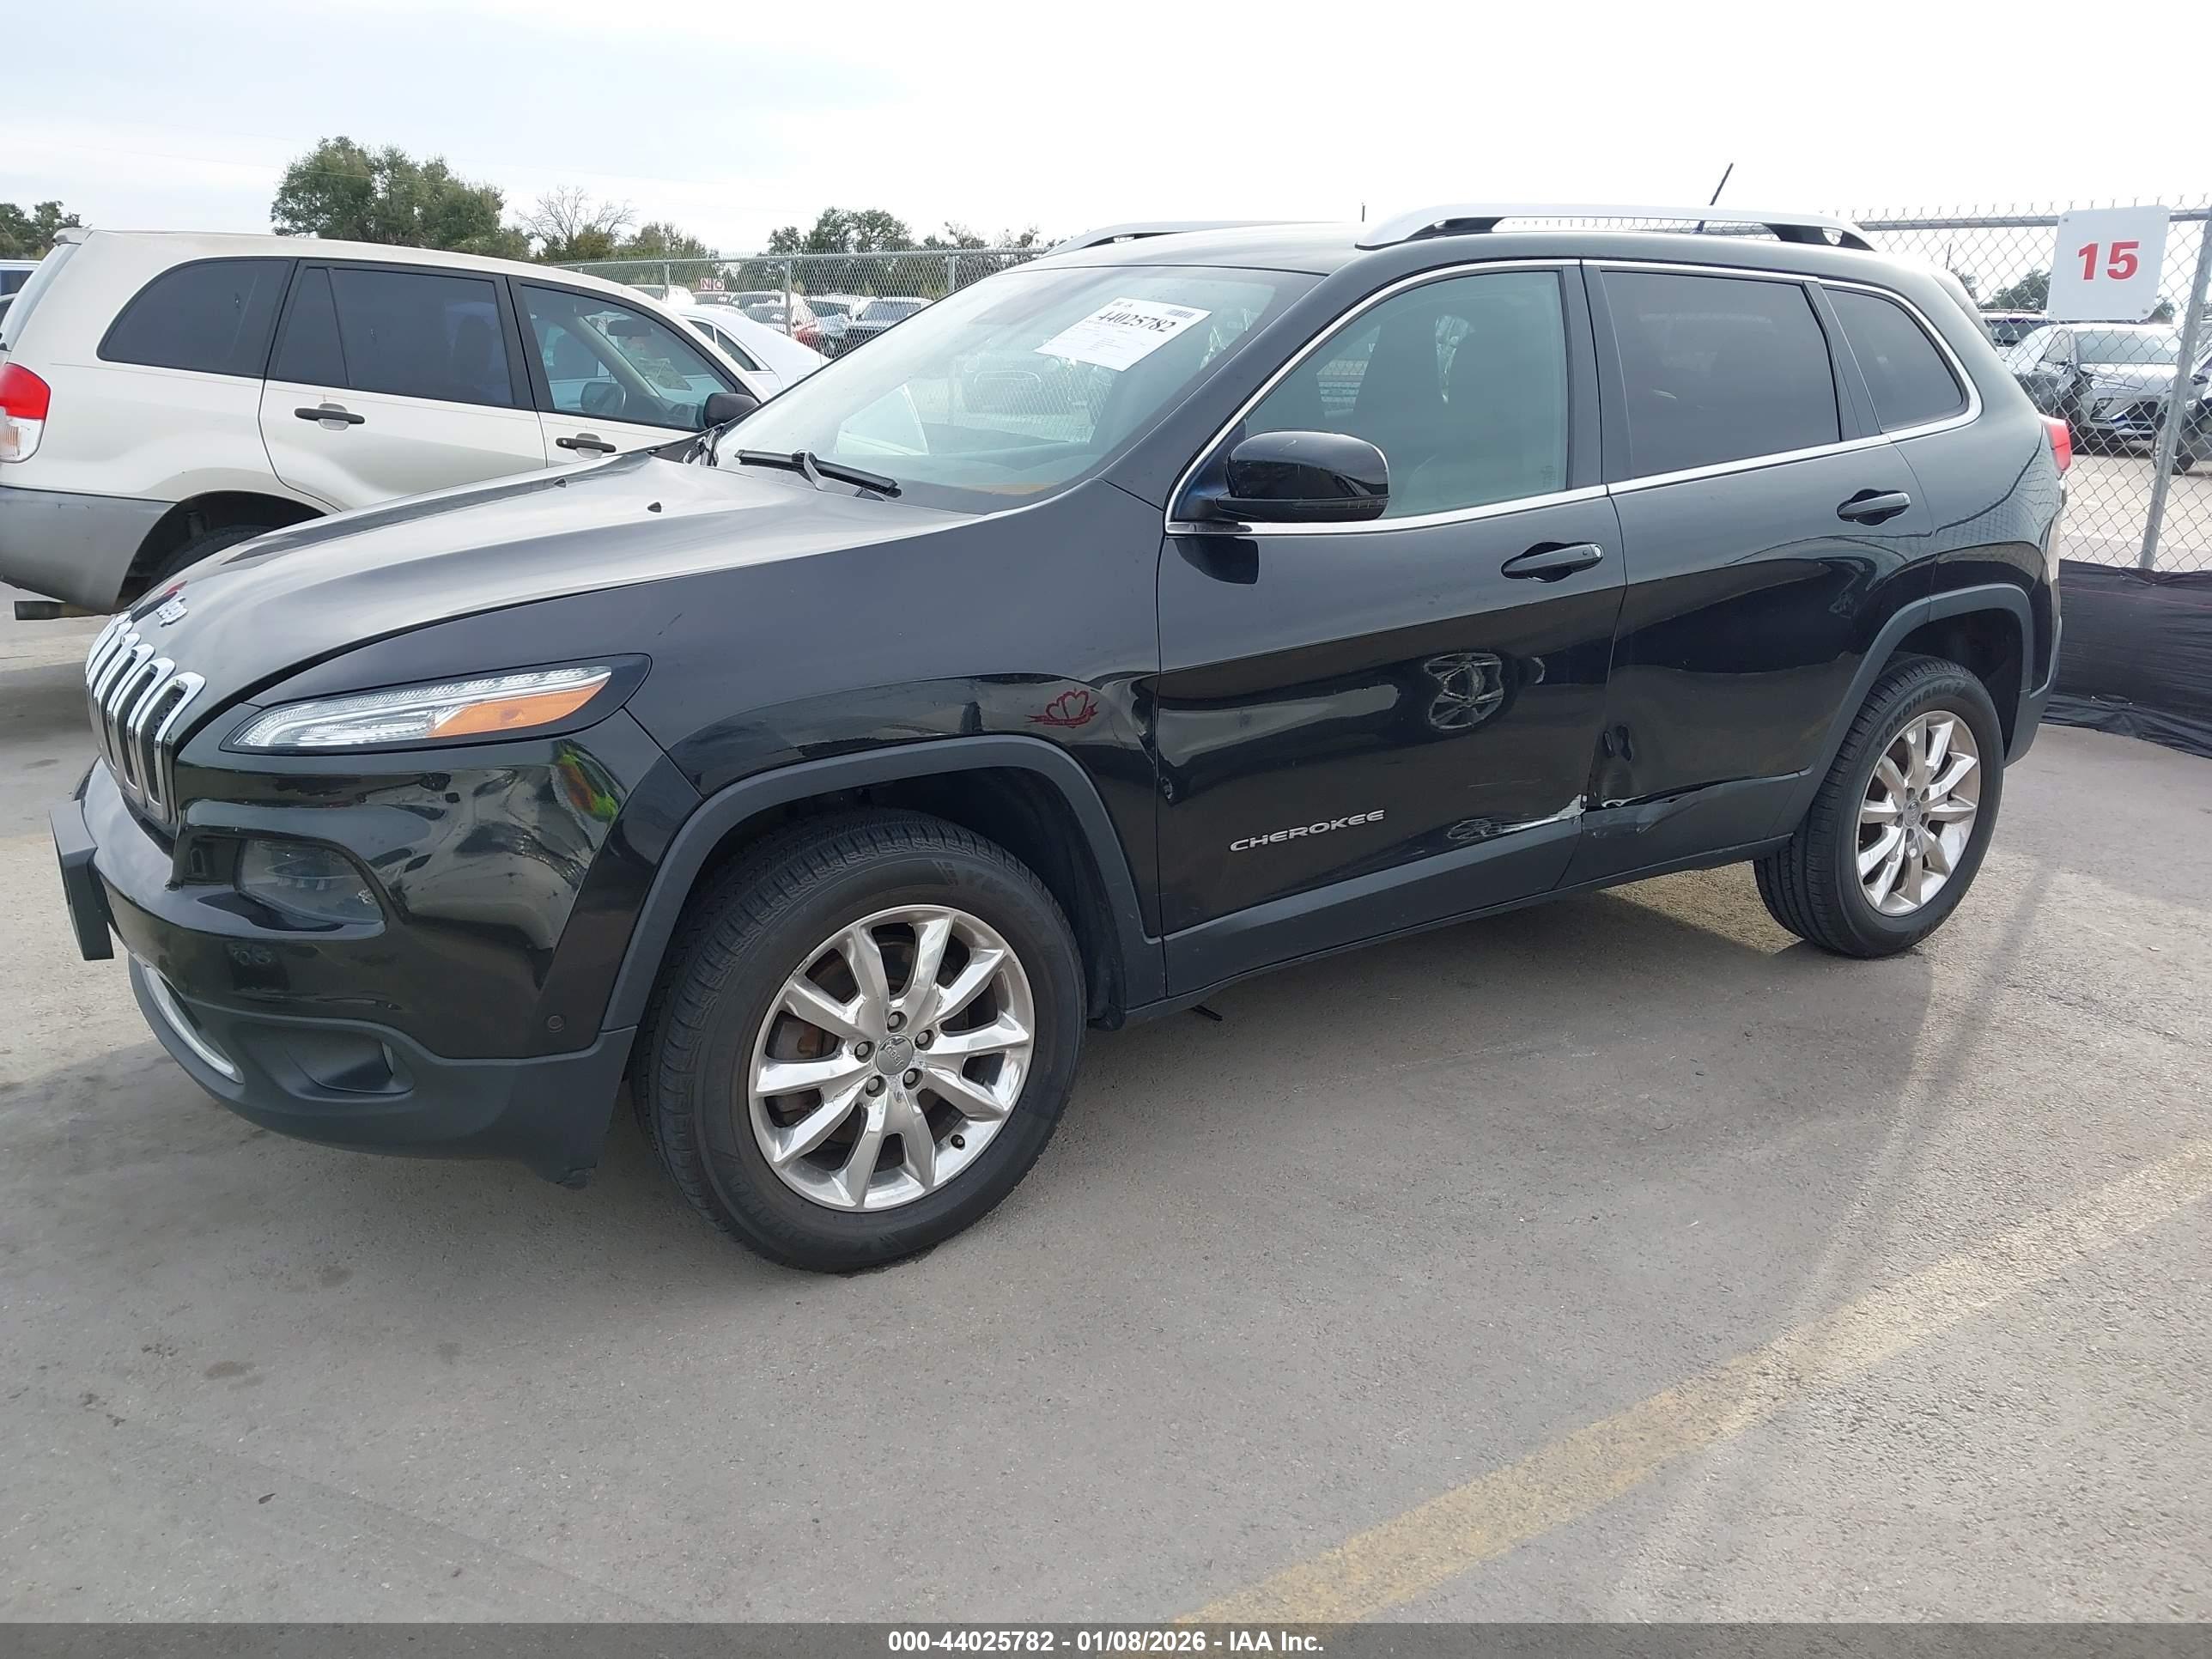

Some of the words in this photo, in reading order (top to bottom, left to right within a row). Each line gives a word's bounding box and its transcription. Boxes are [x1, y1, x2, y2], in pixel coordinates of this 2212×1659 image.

[2077, 240, 2140, 281] 15
[1097, 310, 1177, 333] 44025782
[1229, 810, 1385, 852] CHEROKEE
